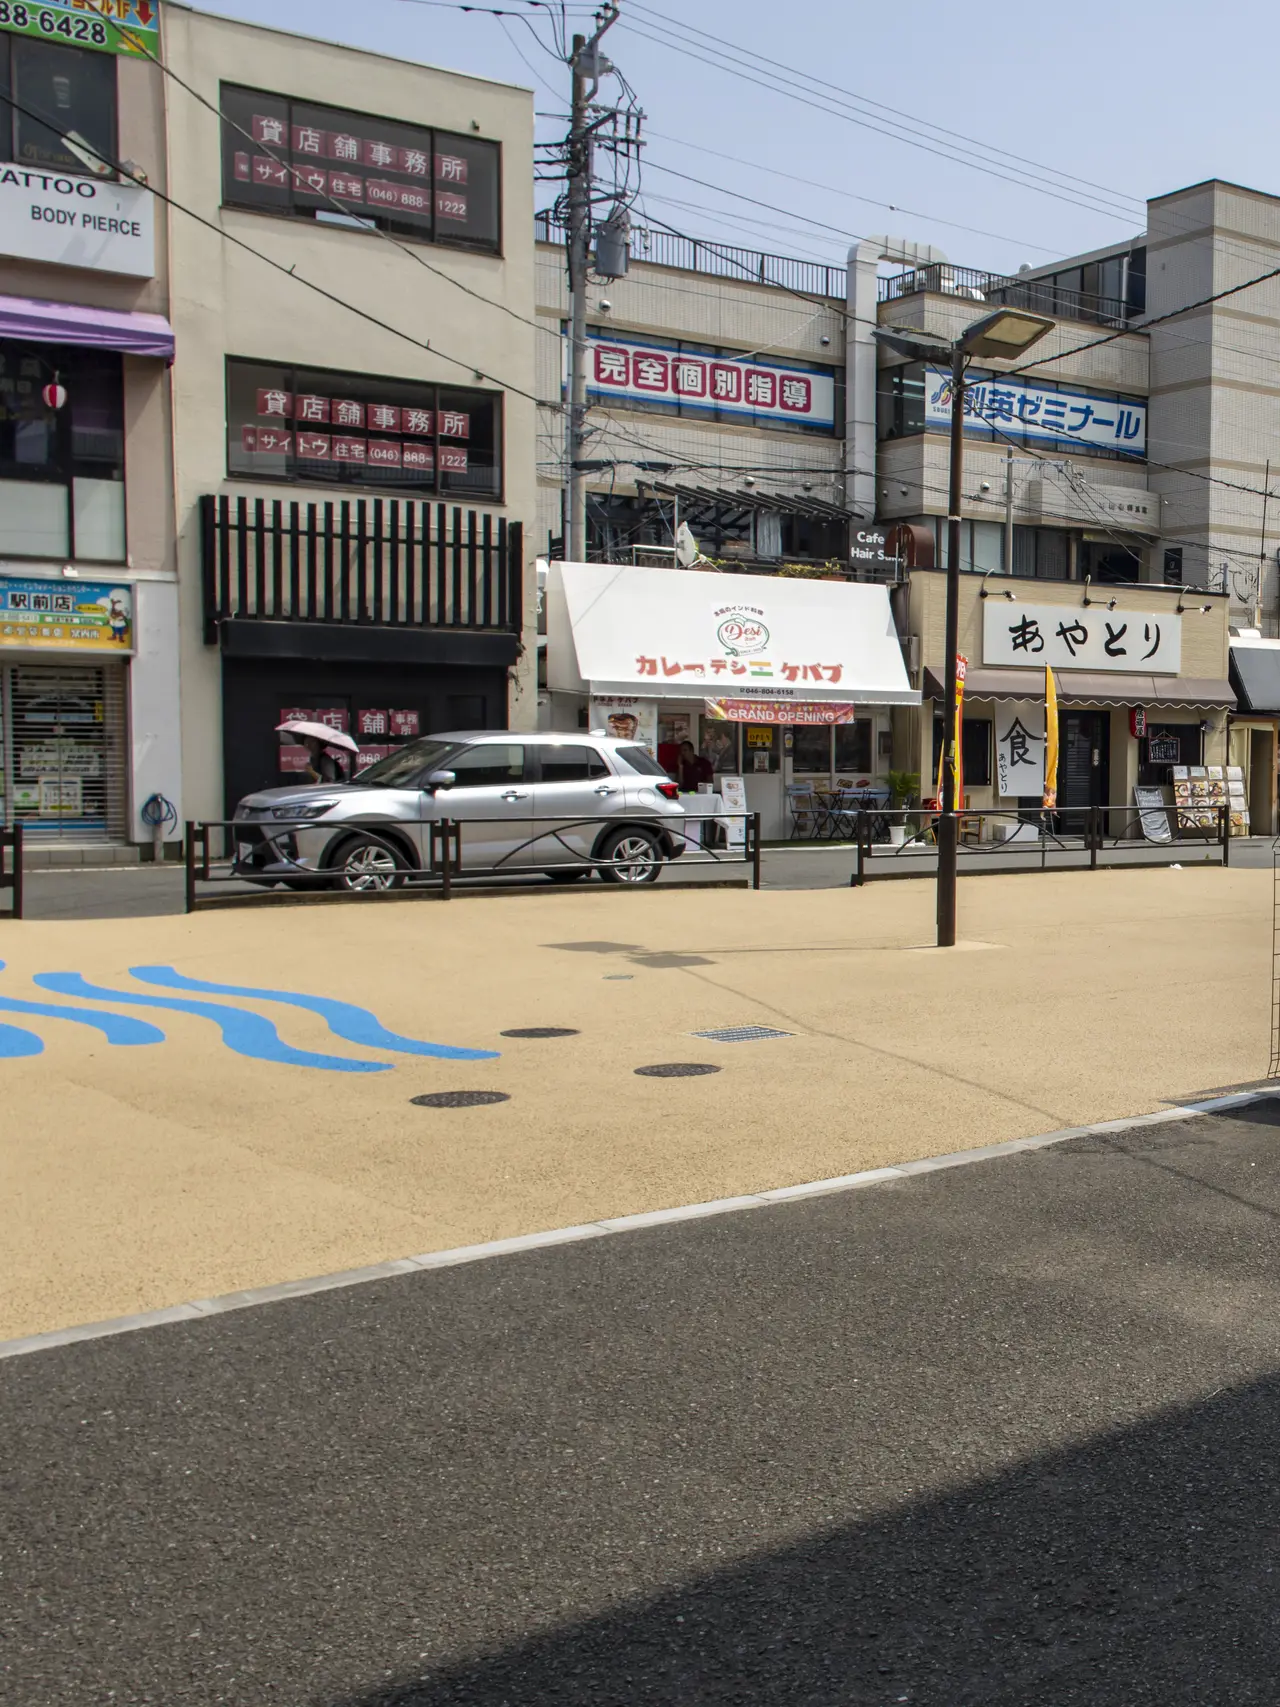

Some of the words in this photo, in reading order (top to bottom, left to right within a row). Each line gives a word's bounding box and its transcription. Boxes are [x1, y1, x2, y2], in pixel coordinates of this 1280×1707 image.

[260, 119, 463, 181] 貸店舗事務所
[0, 168, 96, 198] ATTOO
[31, 205, 76, 226] BODY
[82, 214, 141, 237] PIERCE
[599, 352, 807, 408] 完全個別指導
[264, 392, 465, 436] 貸店舗事務所
[261, 434, 365, 459] サイトウ住宅
[856, 531, 885, 544] Cafe
[851, 546, 875, 559] Hair
[10, 593, 72, 612] 駅前店
[725, 622, 762, 640] Desi
[1008, 614, 1161, 661] あやとり
[710, 659, 747, 675] デシ
[781, 662, 843, 683] ケバブ
[745, 687, 794, 696] 046-804-6158
[728, 708, 774, 721] GRAND
[778, 710, 835, 723] OPENING
[1000, 717, 1043, 767] 食
[999, 753, 1008, 793] あやとり
